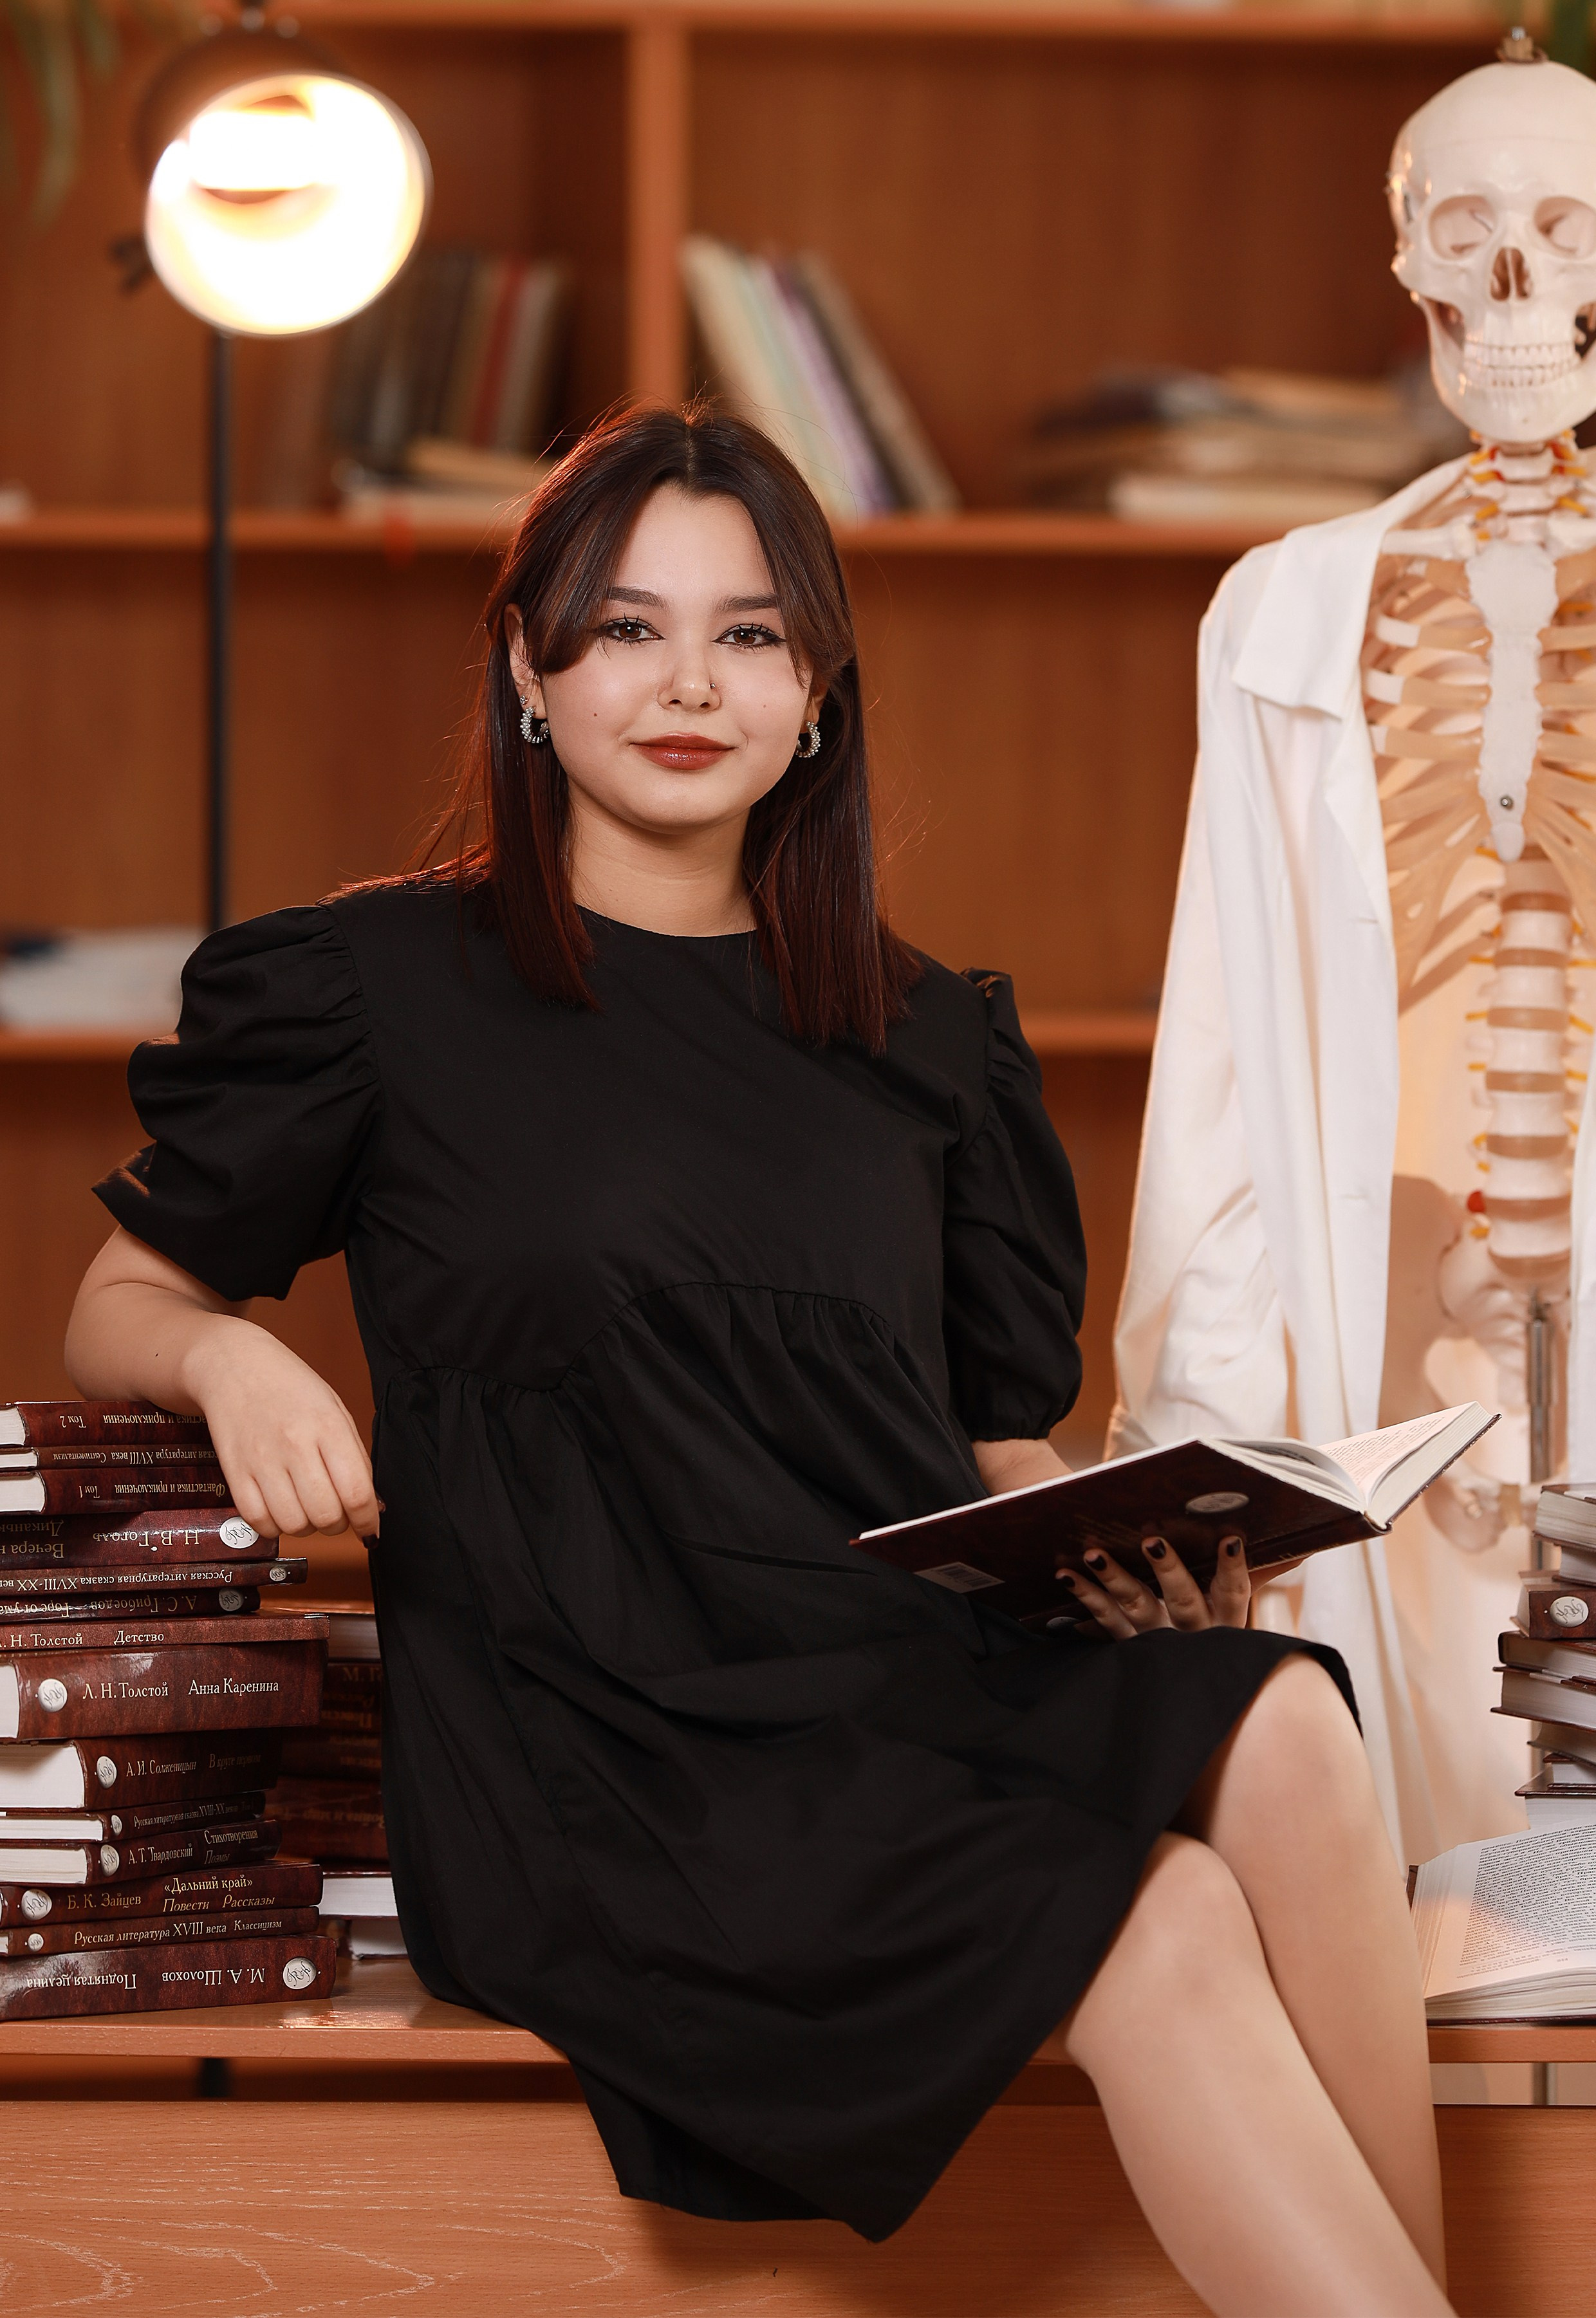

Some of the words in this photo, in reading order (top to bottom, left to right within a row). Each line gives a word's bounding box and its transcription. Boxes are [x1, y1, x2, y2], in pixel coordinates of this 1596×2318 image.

[60, 1416, 67, 1428] 2
[69, 1416, 86, 1428] Том
[103, 1412, 165, 1423] приключения
[53, 1452, 106, 1463] Сентиментализм
[130, 1451, 153, 1464] XVIII
[156, 1449, 196, 1459] литература
[79, 1485, 83, 1497] 1
[85, 1485, 100, 1498] Том
[115, 1481, 168, 1493] приключения
[170, 1484, 175, 1492] и
[177, 1483, 225, 1497] Фантастика
[93, 1531, 150, 1547] Гоголь
[10, 1541, 64, 1559] Вечера
[17, 1578, 78, 1591] XVIII-XX
[117, 1572, 187, 1584] литературная
[190, 1572, 232, 1583] Русская
[24, 1604, 37, 1613] от
[41, 1600, 69, 1617] Горе
[90, 1595, 160, 1613] Грибоедов
[10, 1635, 27, 1647] Н.
[30, 1633, 83, 1647] Толстой
[114, 1630, 165, 1646] Детство
[83, 1683, 97, 1700] Л.
[101, 1683, 116, 1699] Н.
[118, 1682, 169, 1698] Толстой
[189, 1680, 220, 1696] Анна
[223, 1678, 279, 1695] Каренина
[126, 1762, 136, 1777] А.
[137, 1761, 147, 1776] И.
[150, 1759, 197, 1774] Солженицын
[134, 1816, 153, 1829] Русская
[205, 1830, 258, 1844] Стихотворения
[129, 1850, 137, 1865] А.
[138, 1848, 147, 1863] Т.
[148, 1843, 193, 1864] Твардовский
[204, 1850, 230, 1864] Поэмы
[164, 1875, 219, 1894] «Дальний
[221, 1874, 253, 1891] край»
[67, 1895, 79, 1910] Б.
[84, 1894, 97, 1909] К.
[101, 1893, 142, 1909] Зайцев
[162, 1898, 210, 1913] Повести
[222, 1895, 275, 1908] Рассказы
[234, 1920, 282, 1931] Классицизм
[74, 1931, 115, 1947] Русская
[116, 1929, 171, 1942] литература
[173, 1921, 203, 1937] XVIII
[206, 1925, 227, 1935] века
[27, 1974, 70, 1989] целина
[74, 1973, 136, 1989] Поднятая
[162, 1970, 222, 1985] Шолохов
[227, 1969, 243, 1983] А.
[246, 1968, 265, 1983] М.
